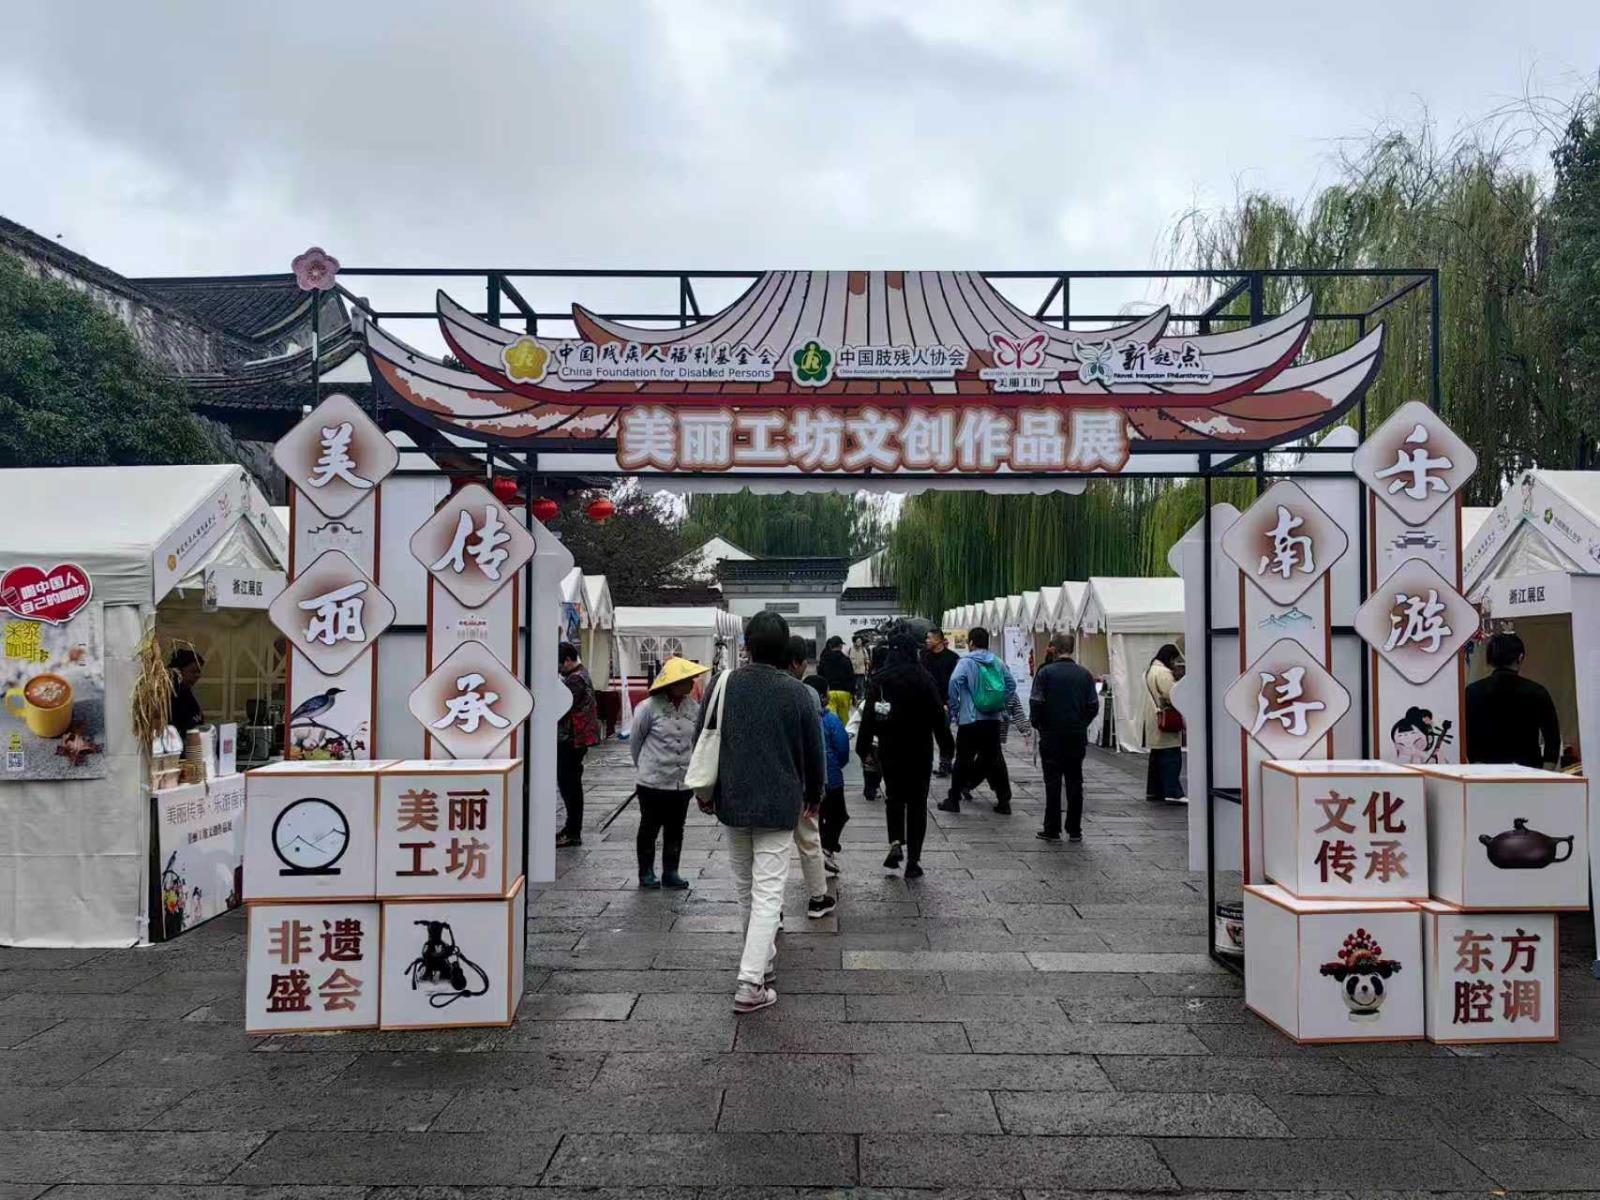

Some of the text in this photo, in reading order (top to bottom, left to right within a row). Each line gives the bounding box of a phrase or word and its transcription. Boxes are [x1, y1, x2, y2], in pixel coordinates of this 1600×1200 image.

[559, 343, 772, 365] 中国残疾人福利基金会
[561, 367, 771, 378] China Foundation for Disabled Persons
[840, 348, 965, 367] 中国肢残人协会
[1118, 344, 1200, 371] 新起点
[623, 407, 1124, 467] 美丽工坊文创作品展
[1508, 585, 1546, 605] 浙江展区
[396, 788, 491, 833] 美丽
[1314, 790, 1407, 835] 文化
[395, 837, 491, 881] 工坊
[1314, 839, 1409, 885] 传承
[267, 917, 365, 965] 非遗
[1453, 928, 1542, 975] 东方
[265, 967, 364, 1013] 盛会
[1452, 978, 1542, 1026] 腔调
